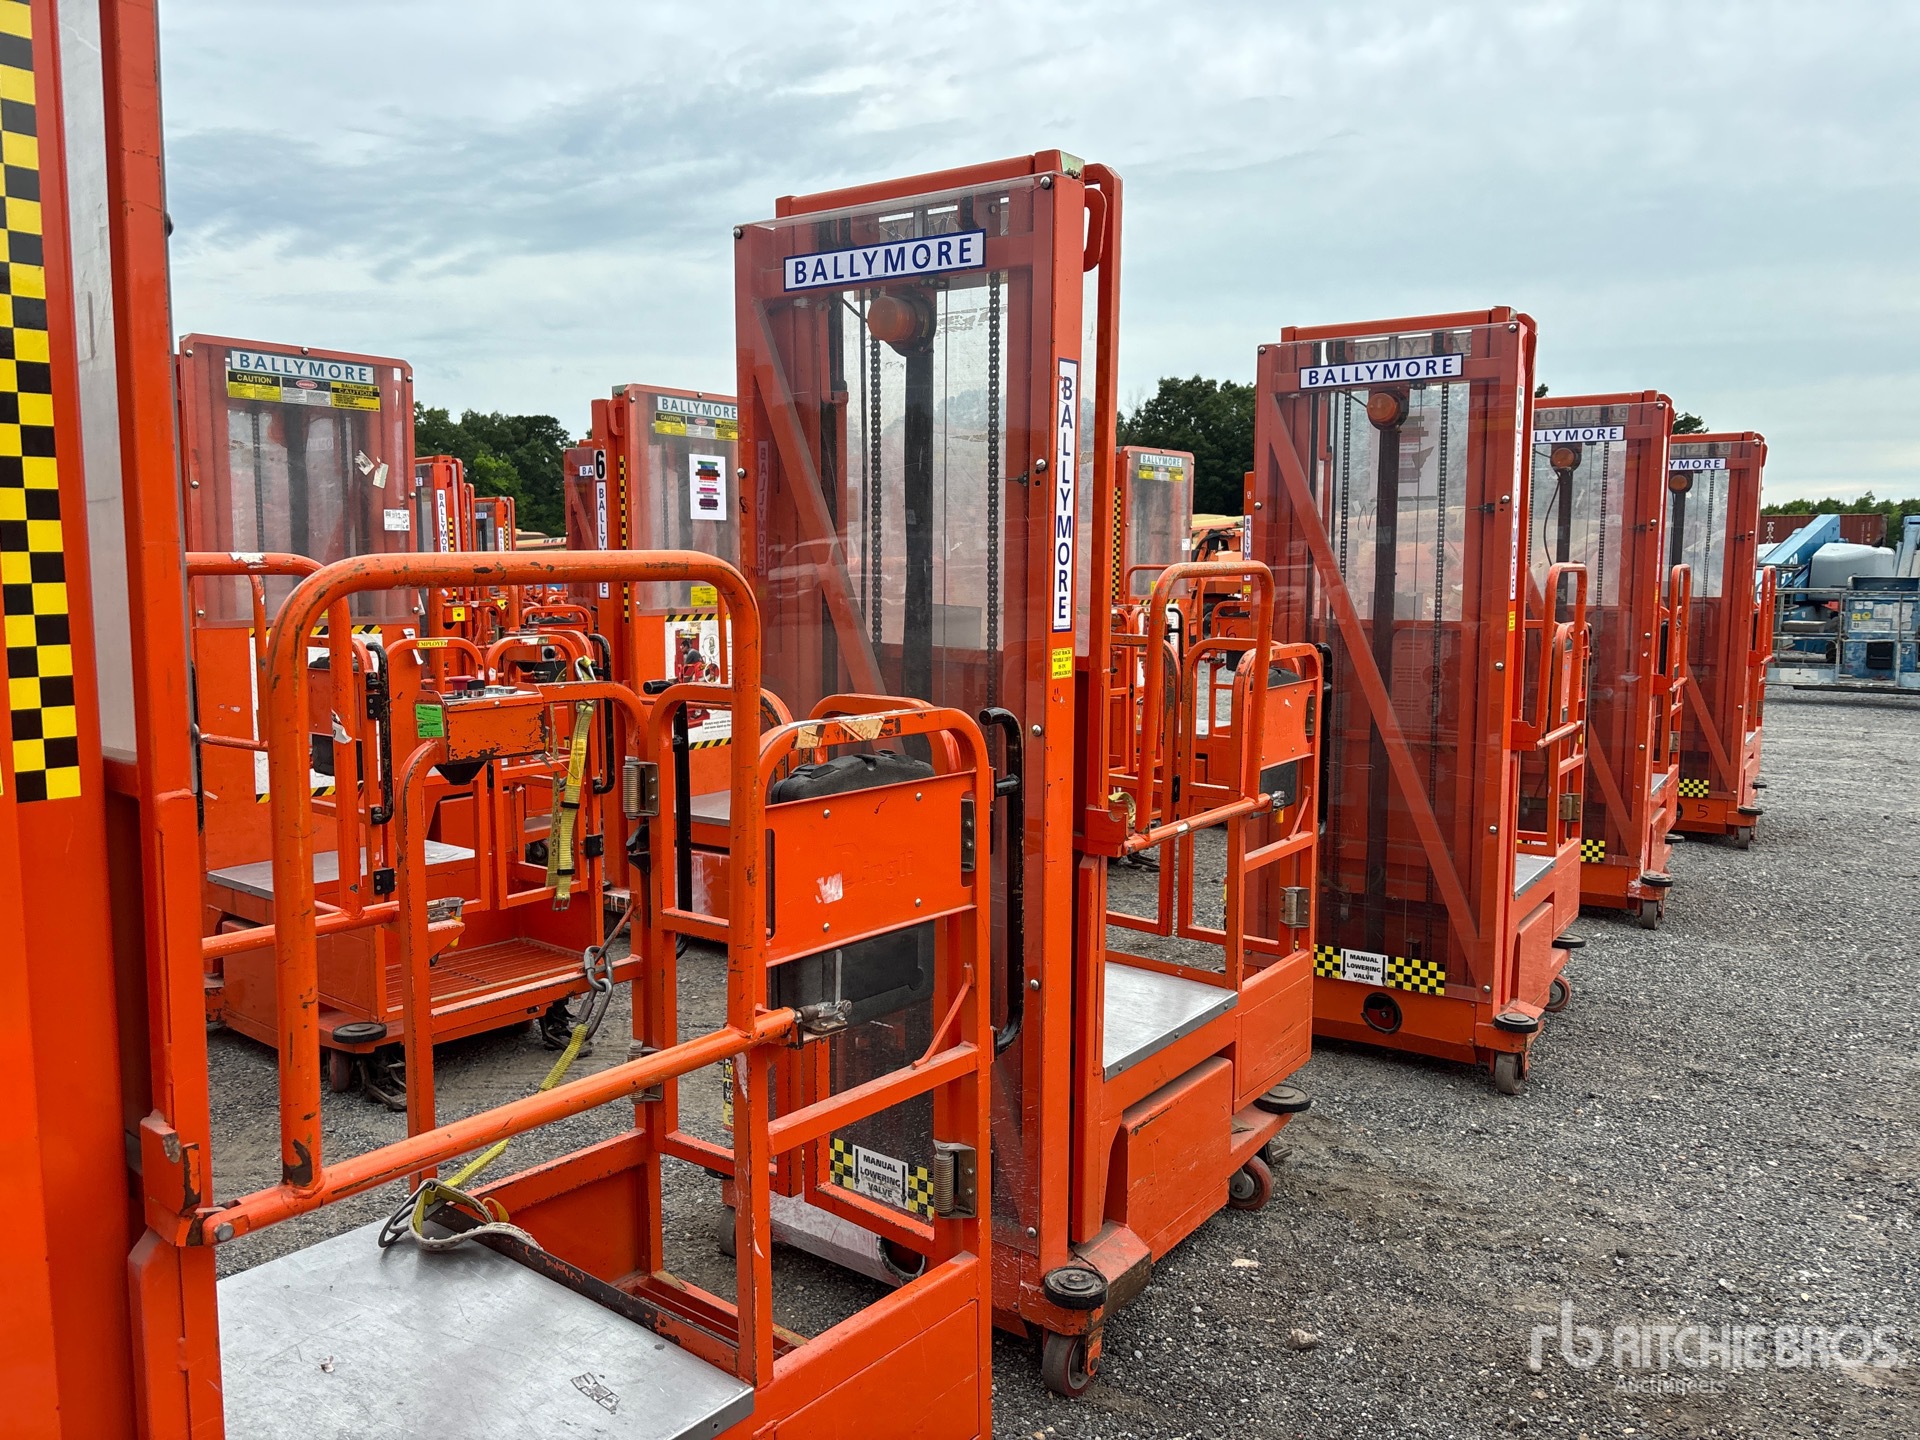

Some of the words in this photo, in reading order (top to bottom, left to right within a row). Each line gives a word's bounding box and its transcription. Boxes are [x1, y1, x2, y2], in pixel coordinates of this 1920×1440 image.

[794, 237, 972, 285] BALLYMORE
[239, 353, 367, 382] BALLYMORE
[1308, 358, 1453, 386] BALLYMORE
[236, 373, 272, 384] CAUTION
[338, 388, 373, 396] CAUTION
[662, 398, 737, 419] BALLYMORE
[595, 450, 606, 480] 6
[1142, 455, 1181, 467] BALLYMORE
[1057, 376, 1073, 619] BALLYMORE
[1696, 804, 1709, 819] 5
[1349, 953, 1379, 964] MANUAL
[1346, 962, 1382, 973] LOWERING
[1353, 972, 1374, 981] VALVE
[863, 1154, 897, 1173] MANUAL
[860, 1166, 901, 1188] LOWERING
[868, 1182, 893, 1198] VALVE
